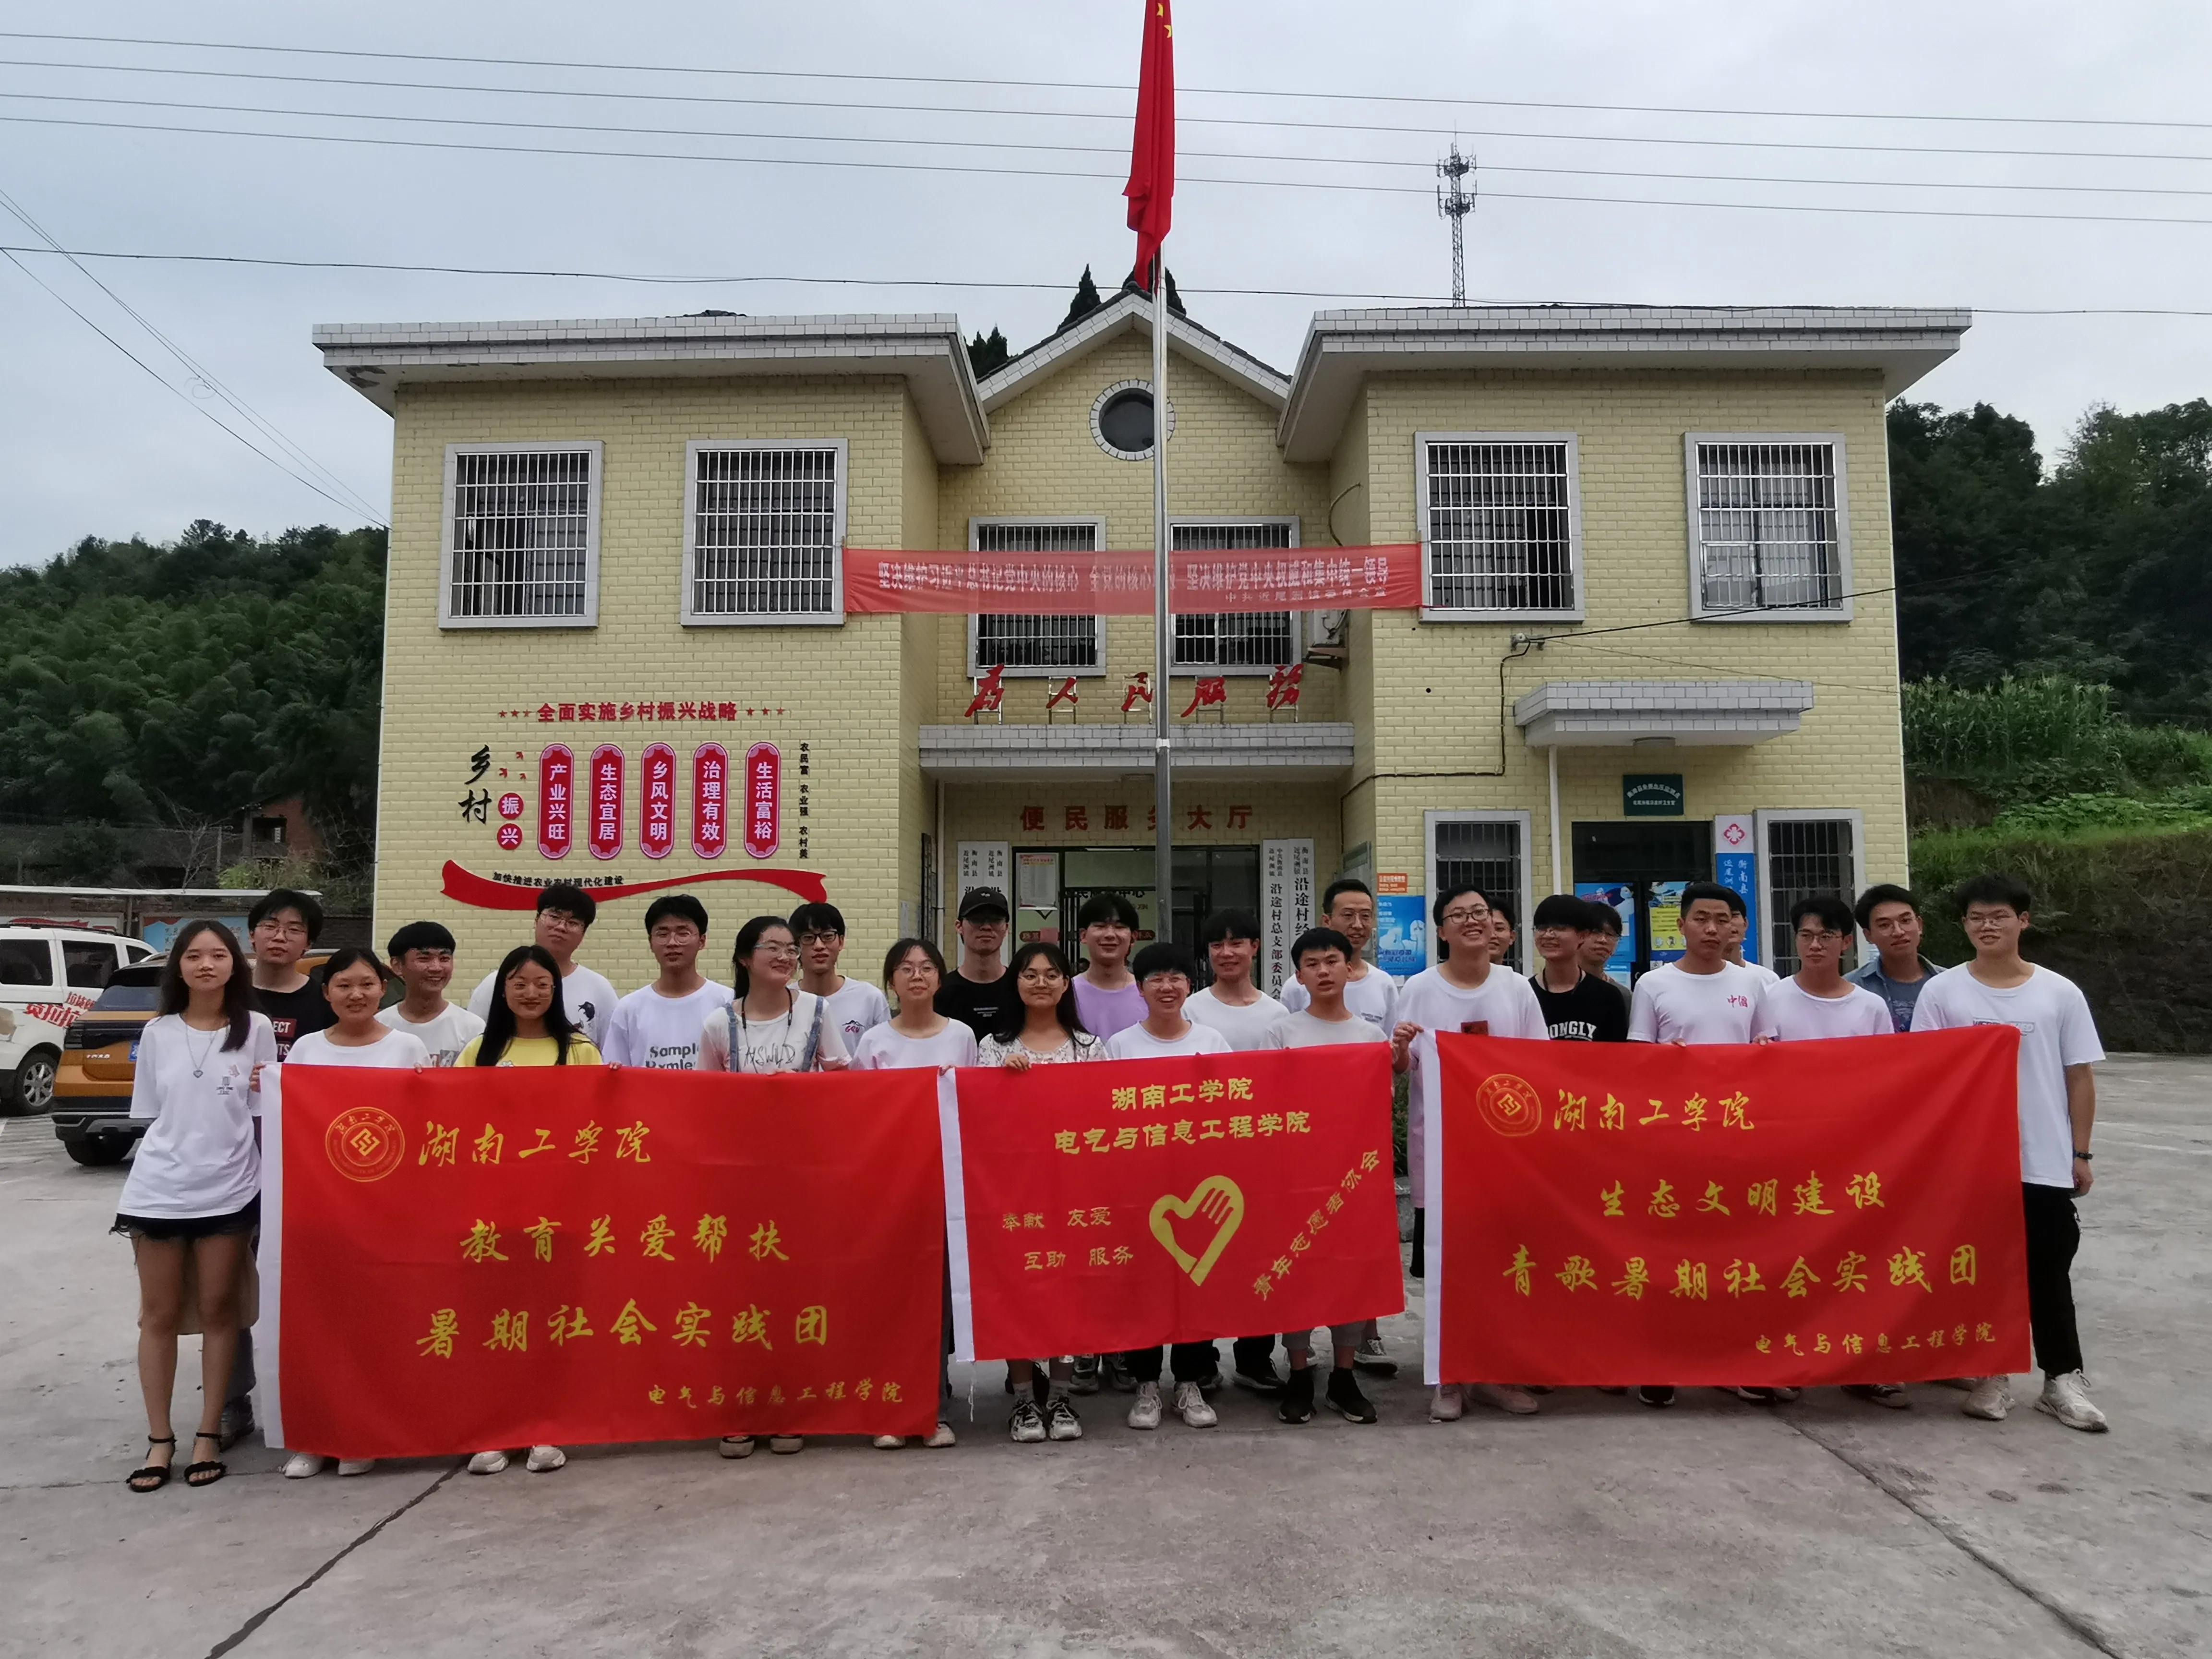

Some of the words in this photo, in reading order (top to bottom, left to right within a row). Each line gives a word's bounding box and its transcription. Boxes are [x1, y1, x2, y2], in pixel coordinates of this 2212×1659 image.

[538, 702, 737, 722] 全面实施乡村振兴战略
[799, 743, 809, 775] 农民富
[458, 745, 493, 824] 乡村
[548, 763, 566, 840] 产业兴旺
[599, 763, 617, 840] 生态宜居
[650, 761, 669, 840] 乡风文明
[702, 761, 721, 841] 治理有效
[755, 762, 773, 839] 生活富裕
[799, 784, 809, 816] 农业强
[501, 797, 520, 845] 振兴
[799, 826, 808, 859] 农村美
[1724, 859, 1733, 889] 近尾洲
[650, 1043, 699, 1058] Sampl
[1549, 1021, 1597, 1039] ONGLY
[1111, 1078, 1254, 1111] 湖南工学院
[1553, 1089, 1755, 1131] 湖南工学院
[418, 1120, 651, 1167] 湖南工学院
[1054, 1111, 1311, 1154] 电气与信息工程学院
[1600, 1170, 1885, 1218] 生态文明建设
[459, 1213, 790, 1263] 教育关爱帮扶
[1002, 1212, 1045, 1232] 奉献
[1067, 1207, 1112, 1227] 友爱
[1252, 1149, 1381, 1302] 青年志愿者协会
[1024, 1250, 1066, 1271] 互助
[1089, 1247, 1134, 1267] 服务
[416, 1298, 828, 1359] 暑期社会实践团
[1754, 1322, 1996, 1357] 电气与信息工程学院
[648, 1379, 903, 1409] 电气与信息工程学院
